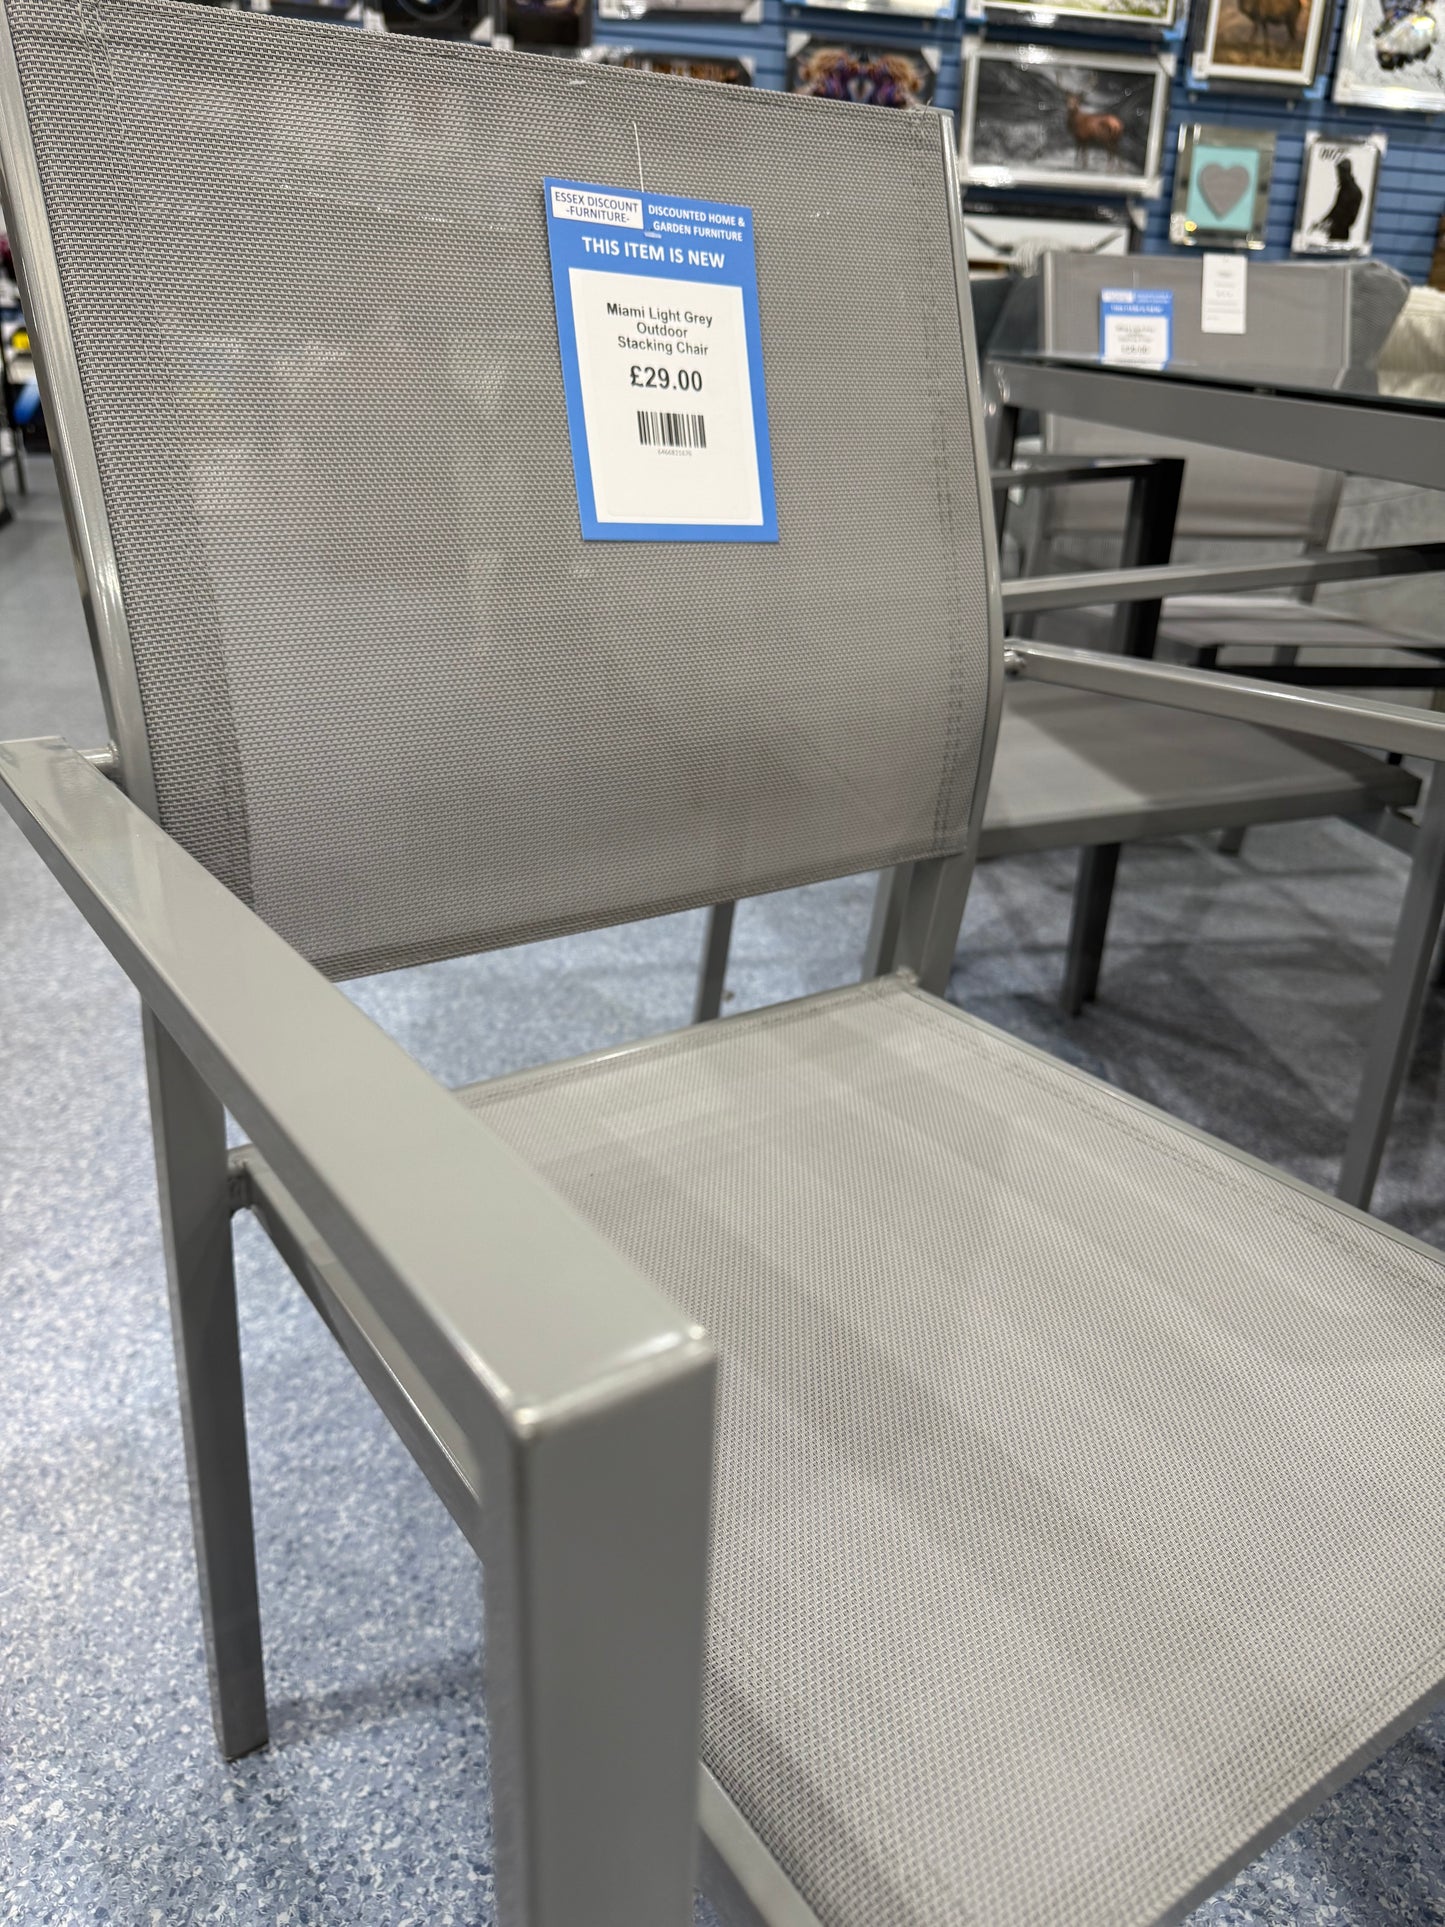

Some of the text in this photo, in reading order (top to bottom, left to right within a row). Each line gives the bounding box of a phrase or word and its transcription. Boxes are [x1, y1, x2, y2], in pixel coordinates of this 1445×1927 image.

[555, 191, 639, 213] ESSEX DISCOUNT
[648, 204, 746, 228] DISCOUNTED HOME &
[653, 220, 744, 242] GARDEN FURNITURE
[581, 236, 725, 269] THIS ITEM IS NEW
[606, 302, 713, 328] Miami Light Grey
[636, 321, 688, 338] Outdoor
[617, 335, 709, 356] Stacking Chair
[630, 365, 703, 392] £29.00
